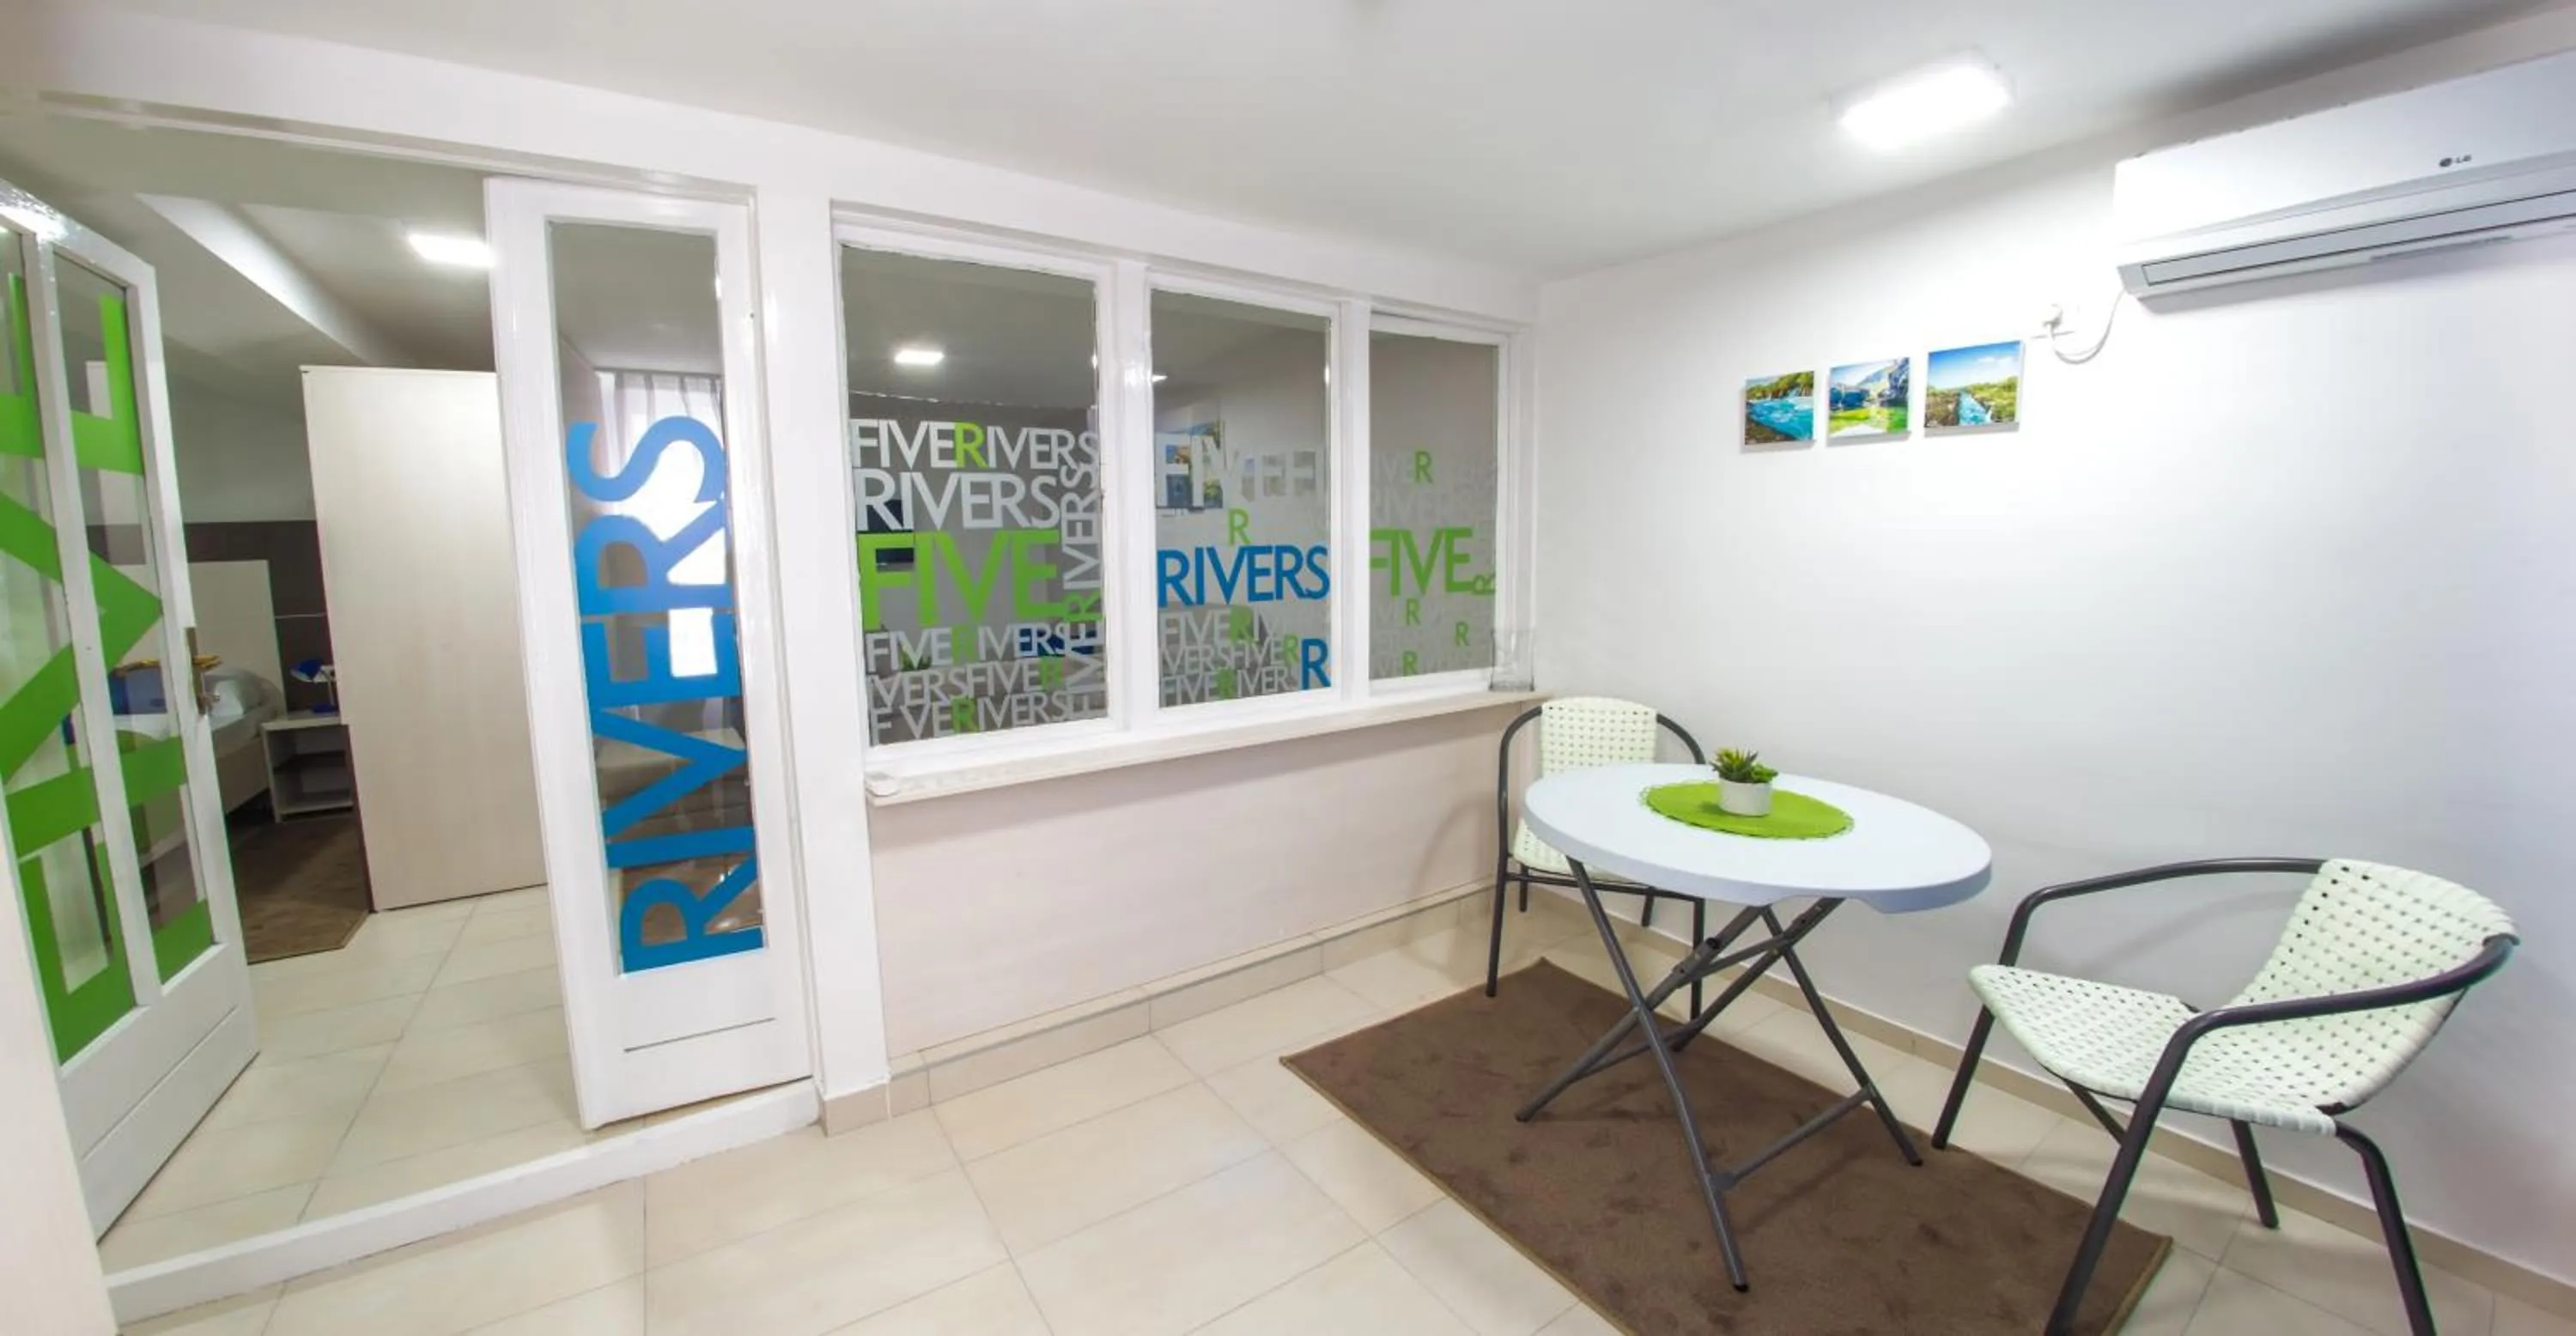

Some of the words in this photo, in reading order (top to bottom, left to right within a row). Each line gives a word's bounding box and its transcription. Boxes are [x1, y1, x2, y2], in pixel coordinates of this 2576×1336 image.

[854, 469, 1061, 531] RIVERS
[1228, 508, 1251, 545] R
[858, 528, 1068, 632] FIVE
[1157, 544, 1331, 607] RIVERS
[567, 415, 765, 974] RIVERS
[1300, 638, 1332, 691] R
